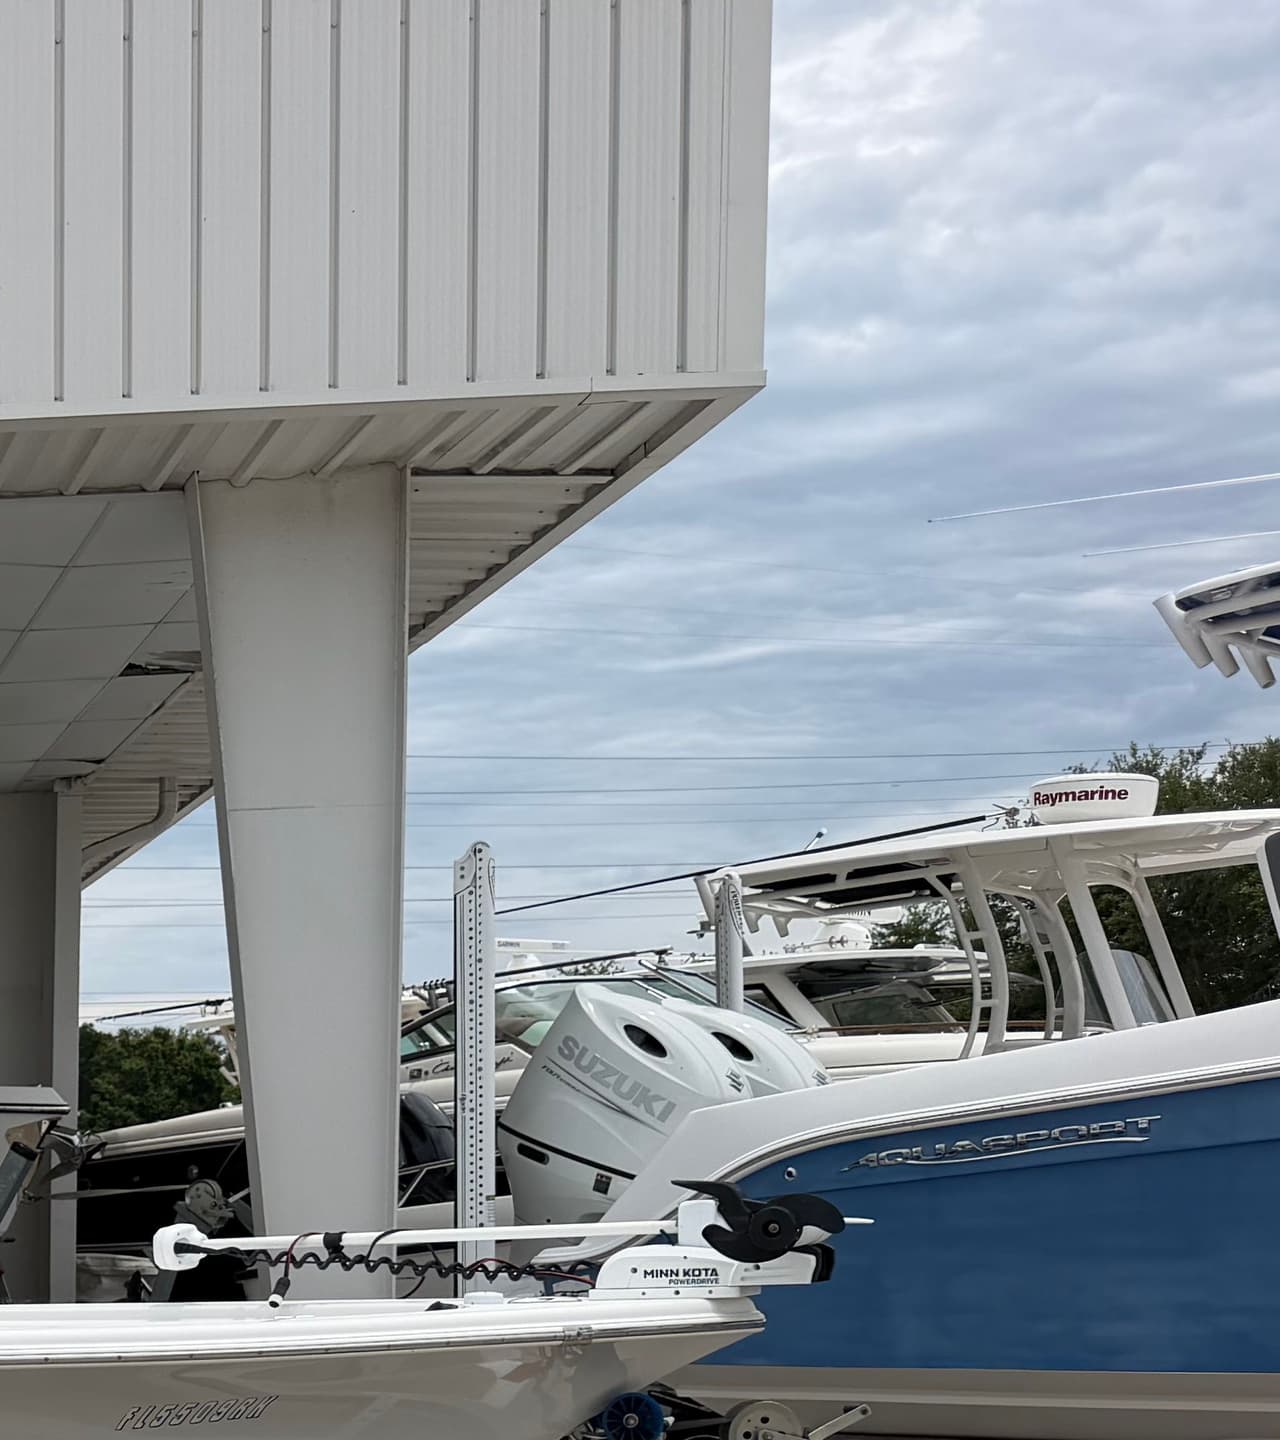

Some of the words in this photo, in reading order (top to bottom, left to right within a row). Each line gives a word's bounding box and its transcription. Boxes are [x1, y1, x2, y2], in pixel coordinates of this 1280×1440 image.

[1033, 785, 1129, 807] Raymarine
[557, 1034, 677, 1123] SUZUKI
[840, 1115, 1162, 1173] AQUASPORT
[643, 1268, 680, 1279] MINN
[682, 1267, 719, 1278] KOTA
